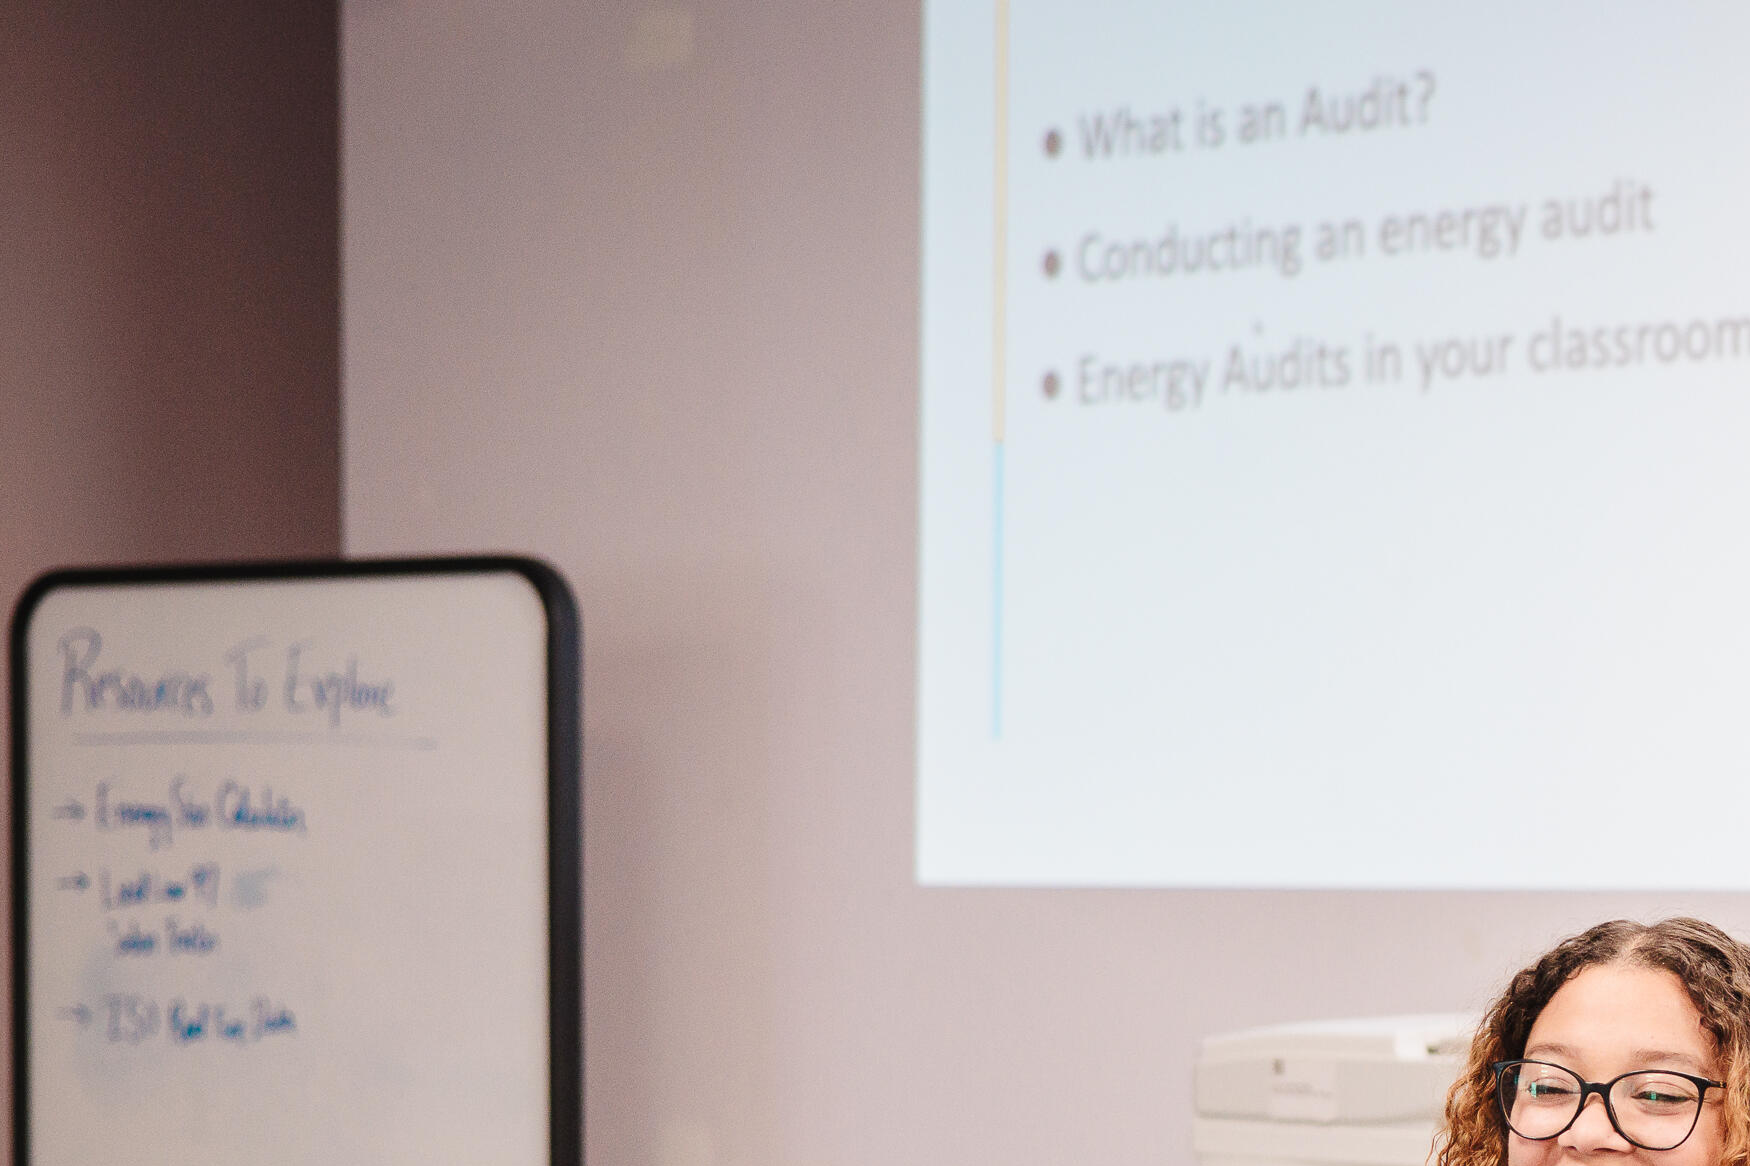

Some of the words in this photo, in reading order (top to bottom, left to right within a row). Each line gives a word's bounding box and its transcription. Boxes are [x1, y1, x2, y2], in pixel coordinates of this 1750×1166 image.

[1078, 106, 1182, 161] What
[1196, 99, 1226, 148] is
[1238, 99, 1286, 146] an
[1300, 71, 1436, 140] Audit?
[1078, 217, 1303, 283] Conducting
[1314, 216, 1366, 263] an
[1379, 200, 1527, 261] energy
[1540, 179, 1658, 241] audit
[1078, 353, 1210, 412] Energy
[1222, 336, 1351, 397] Audits
[1367, 332, 1402, 385] in
[1416, 331, 1515, 394] your
[225, 635, 272, 711] To
